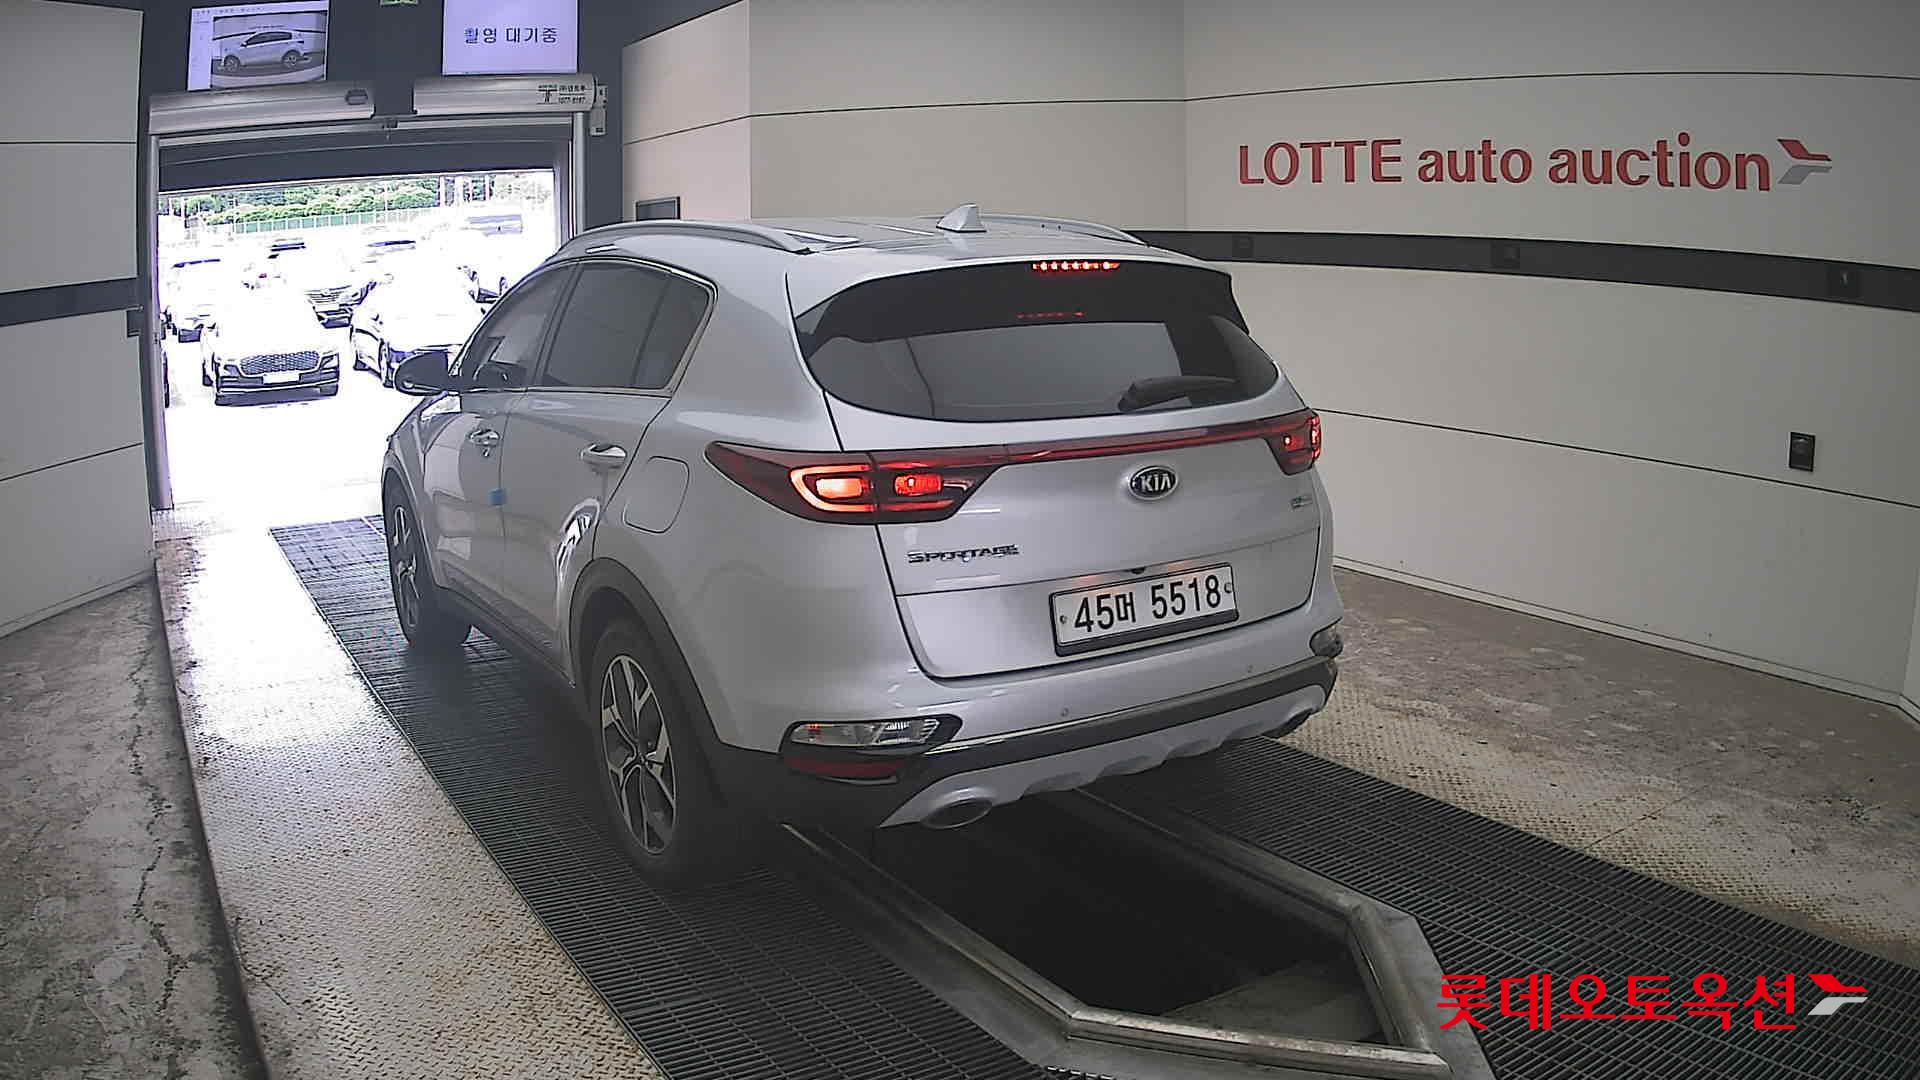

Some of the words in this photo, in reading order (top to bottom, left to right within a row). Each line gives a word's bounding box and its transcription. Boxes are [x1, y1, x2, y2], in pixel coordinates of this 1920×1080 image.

[505, 27, 558, 43] 대기중
[1238, 138, 1403, 186] LOTTE
[1417, 139, 1533, 185] auto
[1548, 131, 1771, 191] auction
[1140, 473, 1171, 491] KIA
[907, 544, 1019, 563] SPORTAGE
[1074, 591, 1137, 633] 45머
[1150, 574, 1222, 620] 5518
